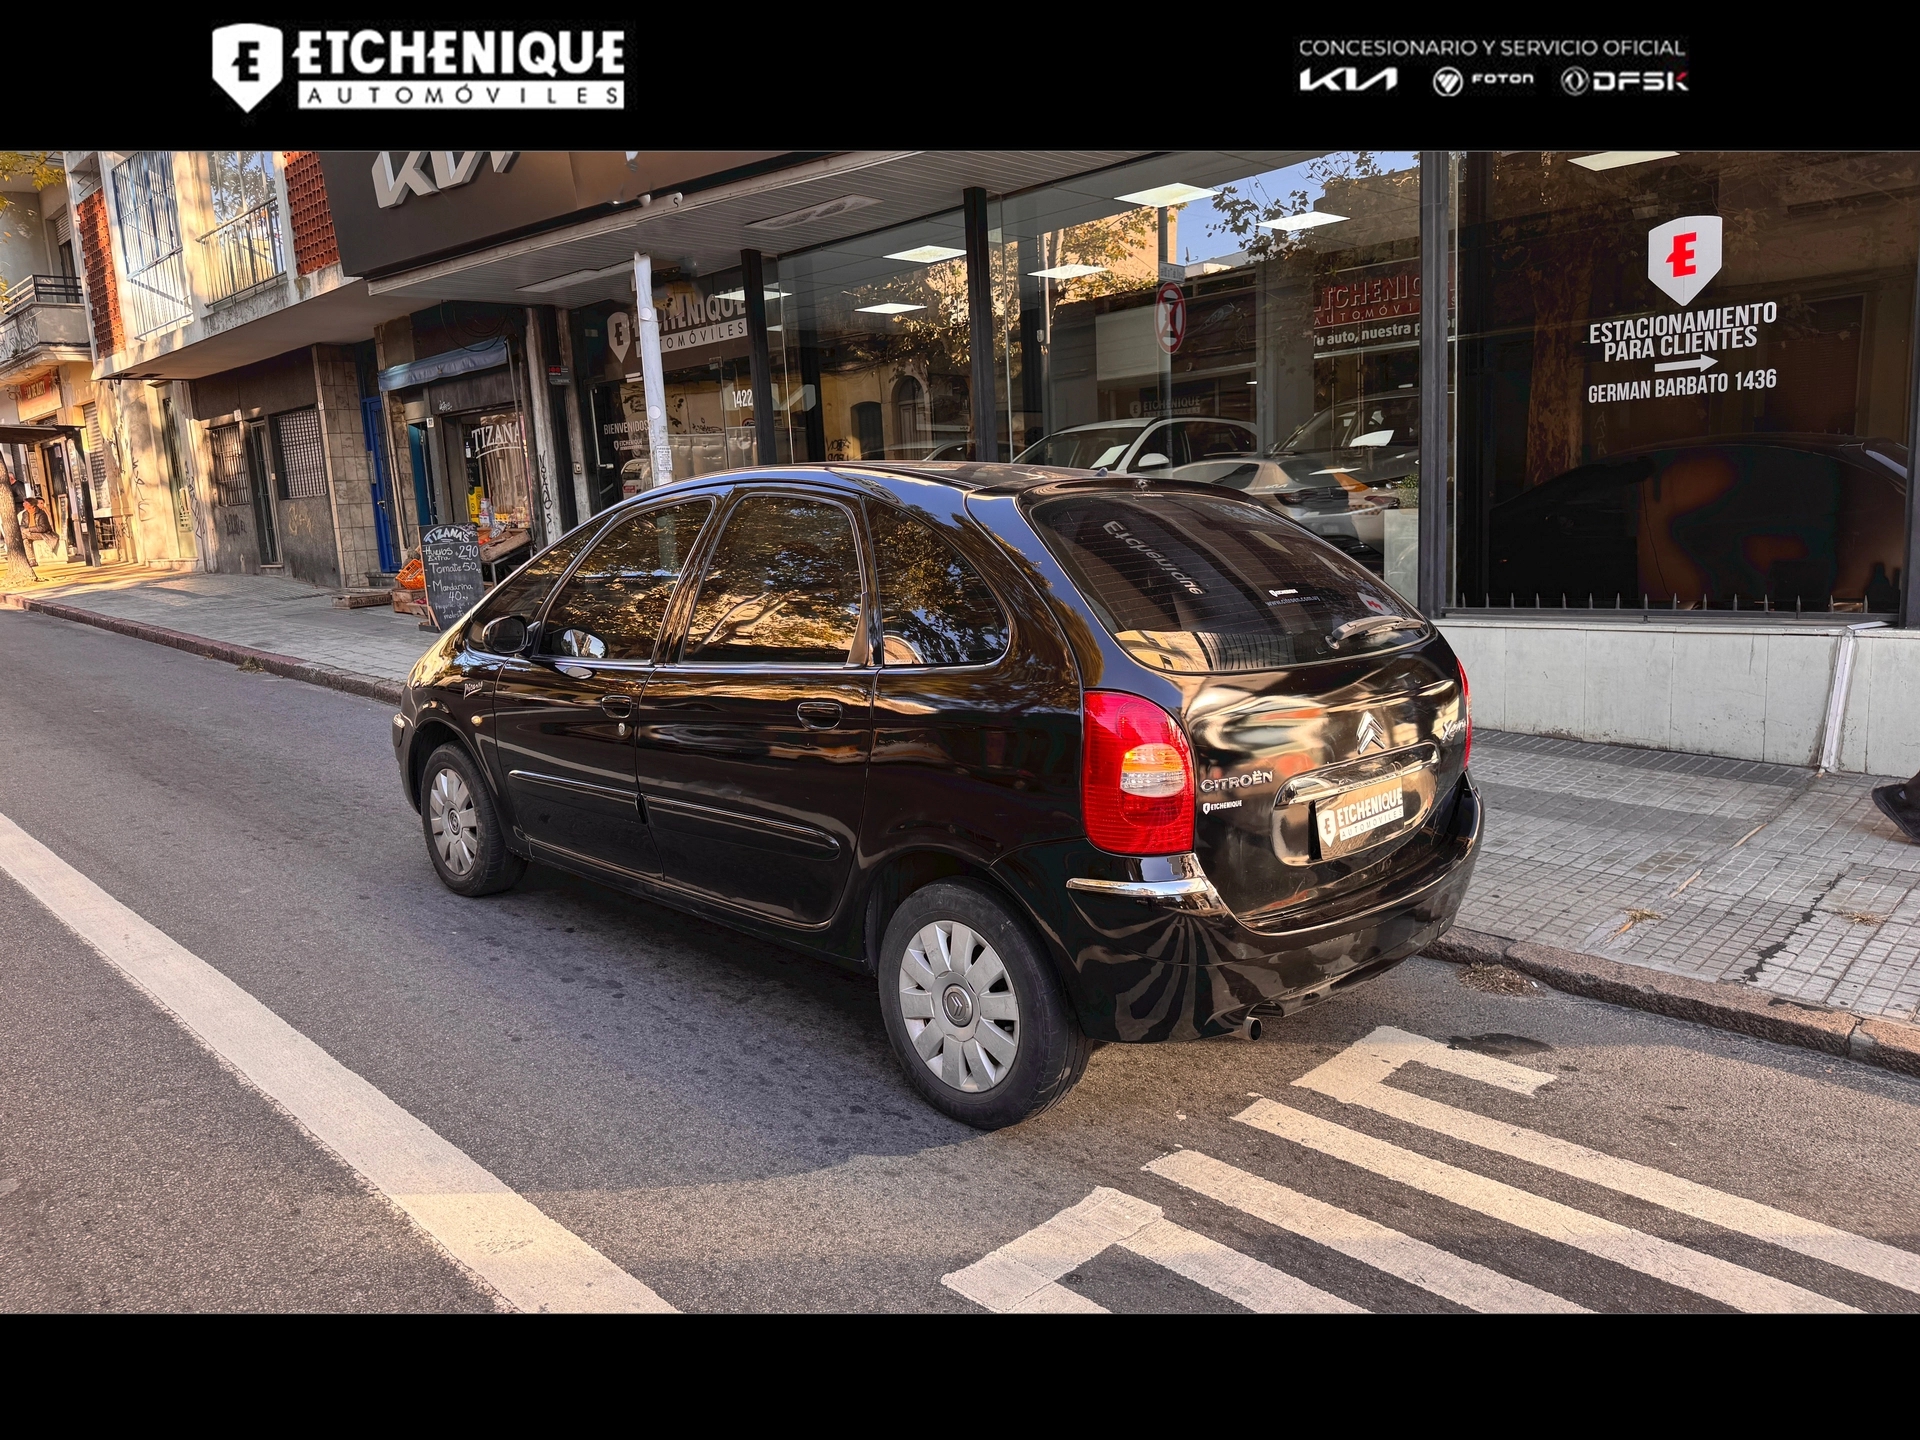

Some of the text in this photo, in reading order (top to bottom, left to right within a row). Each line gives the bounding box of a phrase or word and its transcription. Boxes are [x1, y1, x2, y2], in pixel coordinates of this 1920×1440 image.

[1362, 324, 1411, 340] nuestra
[1590, 301, 1778, 344] ESTACIONAMIENTO
[1604, 325, 1758, 362] PARA CLIENTES
[1588, 368, 1777, 403] GERMAN BARBATO 1436
[732, 388, 754, 408] 1422
[1143, 396, 1200, 411] ETCHENIQUE
[603, 420, 649, 435] BIENVENIDOS
[424, 527, 469, 544] TIZANA'S
[1200, 771, 1273, 794] CITROËN
[1210, 800, 1243, 811] ETCHENIQUE
[1337, 789, 1404, 827] ETCHENIQUE
